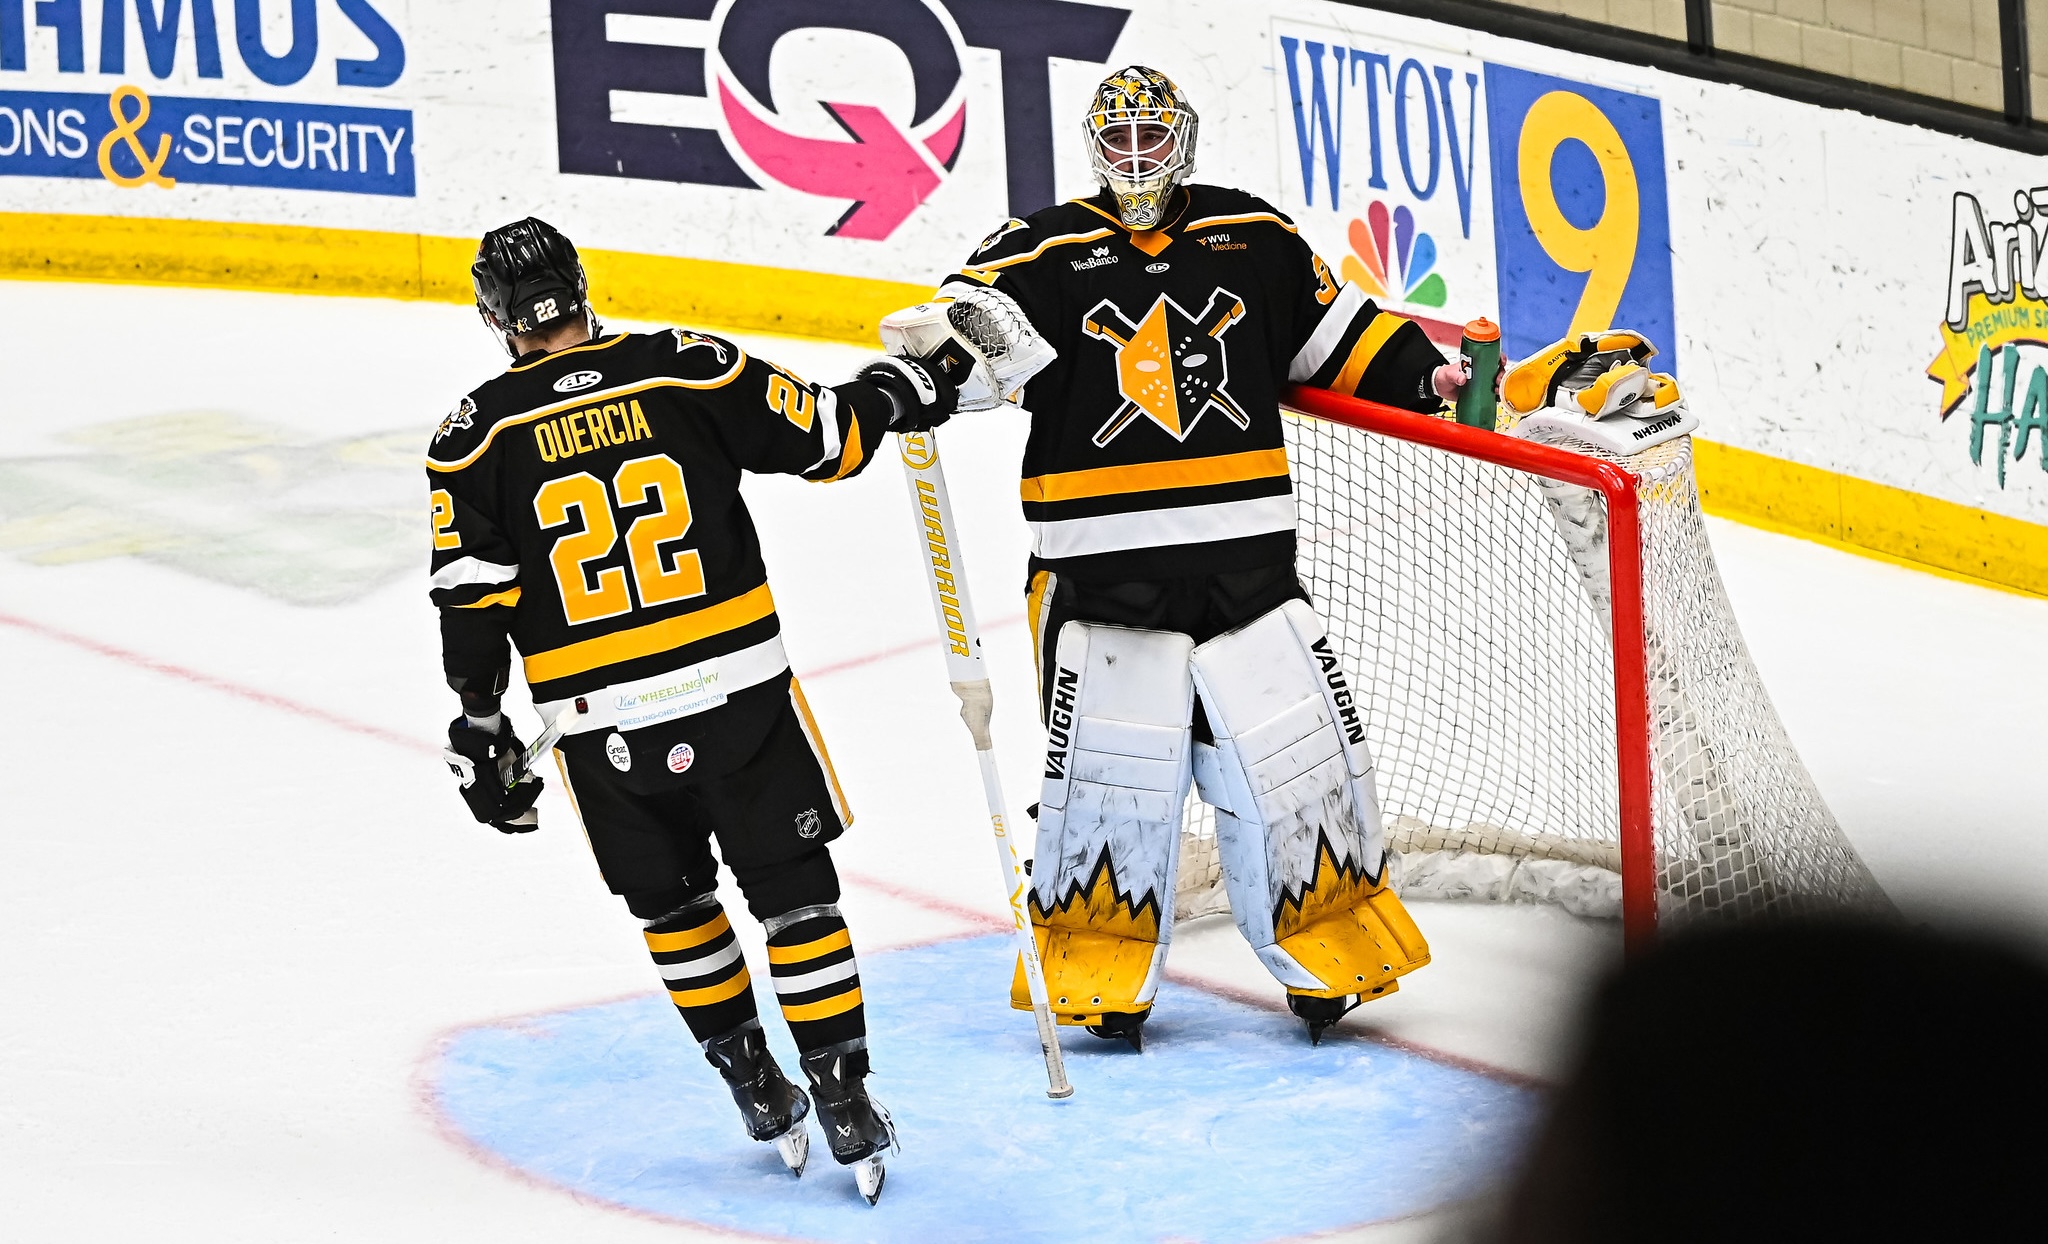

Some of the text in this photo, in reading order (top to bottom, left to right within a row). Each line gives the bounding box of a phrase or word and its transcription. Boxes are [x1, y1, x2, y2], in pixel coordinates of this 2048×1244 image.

[97, 85, 176, 189] &
[182, 114, 405, 175] SECURITY
[551, 0, 1131, 241] EQT
[1280, 36, 1478, 239] WTOV
[1121, 191, 1159, 227] 33
[1518, 91, 1639, 339] 9
[1207, 233, 1231, 243] WVU
[1211, 242, 1247, 252] Medicine
[1070, 255, 1119, 272] WesBanco
[533, 297, 560, 323] 22
[1965, 308, 2030, 348] PREMIUM
[533, 399, 653, 463] QUERCIA
[1632, 413, 1682, 441] VAUGHN
[533, 453, 708, 626] 22
[915, 479, 970, 658] WARRIOR
[639, 678, 701, 703] WHEELING
[703, 672, 719, 685] WV
[678, 698, 709, 712] COUNTY
[1311, 635, 1366, 746] VAUGHN
[1045, 666, 1079, 781] VAUGHN
[608, 744, 628, 754] Great
[612, 754, 629, 766] Clips
